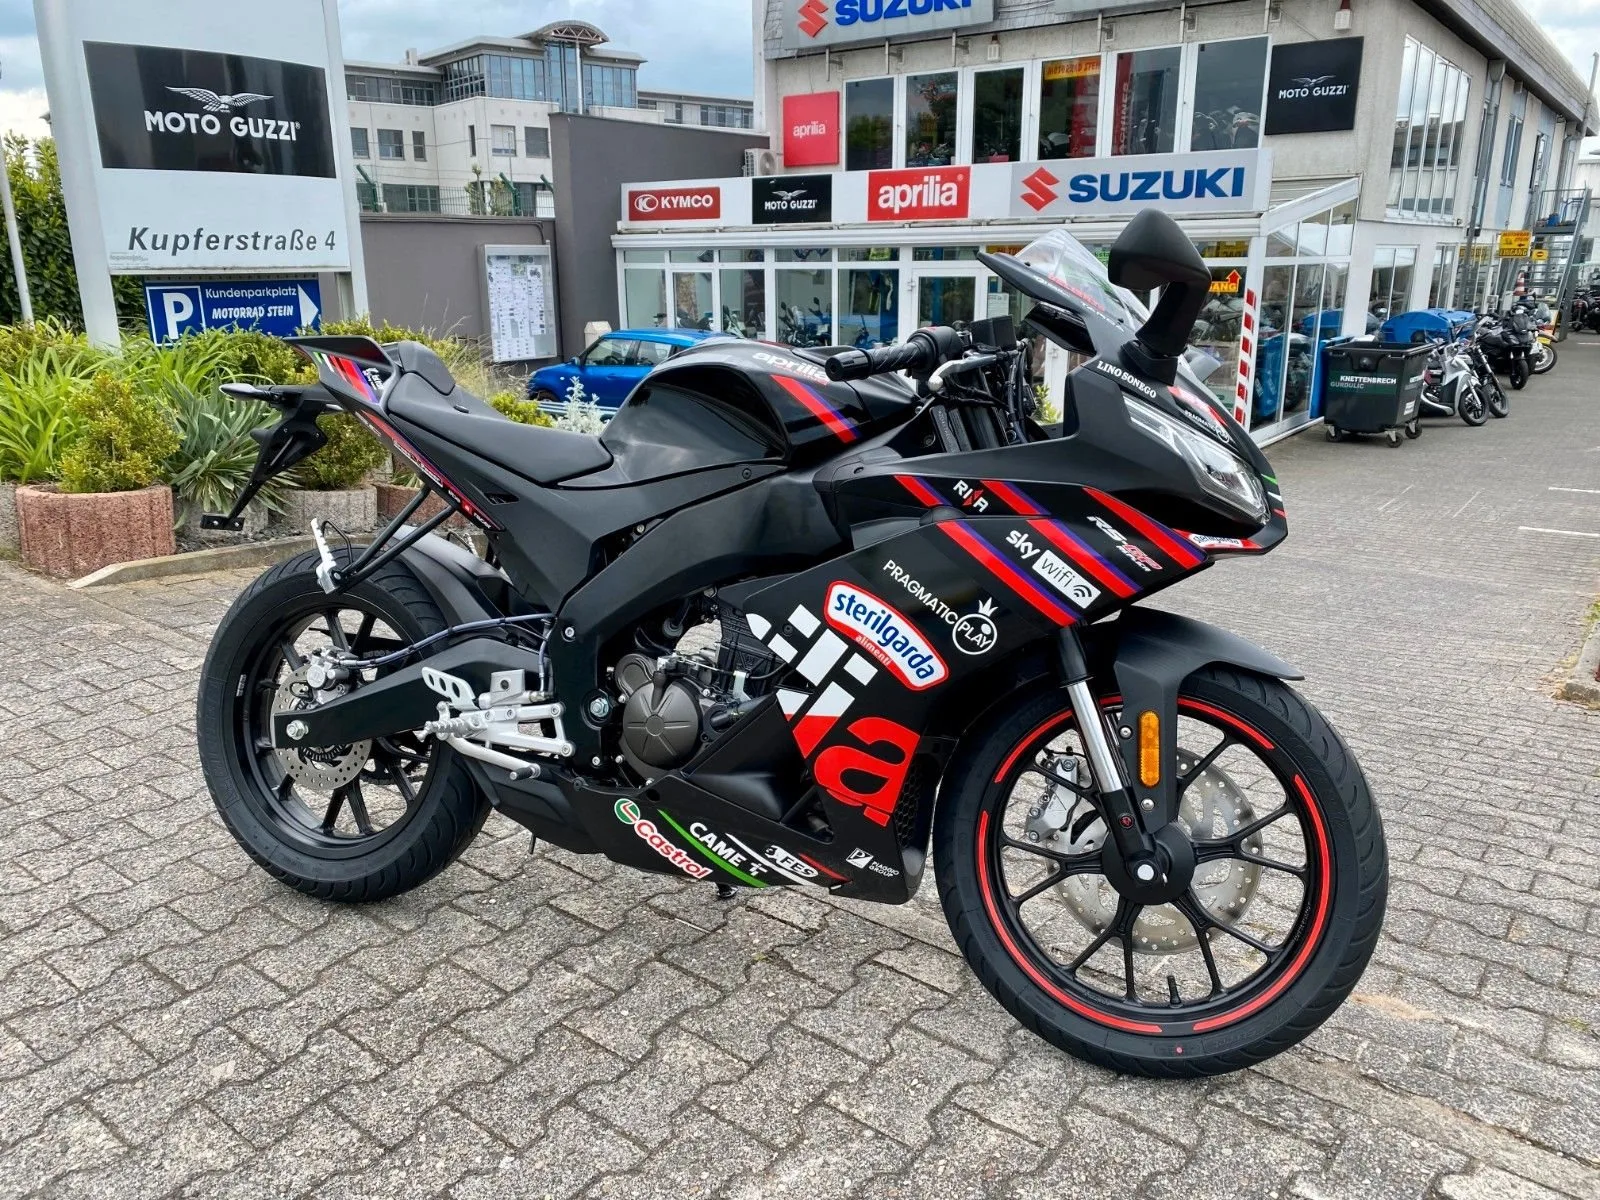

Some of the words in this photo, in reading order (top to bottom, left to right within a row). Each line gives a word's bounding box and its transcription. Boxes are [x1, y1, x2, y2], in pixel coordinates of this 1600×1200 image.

[834, 0, 972, 26] SUZU
[1278, 88, 1309, 99] MOTO
[1312, 85, 1347, 96] GUZZI
[143, 110, 221, 135] MOTO
[229, 116, 297, 141] GUZZI
[793, 121, 826, 138] aprilia
[878, 175, 958, 214] aprilia
[1068, 167, 1245, 203] SUZUKI
[661, 194, 713, 209] KYMCO
[764, 200, 788, 210] MOTO
[790, 199, 816, 209] GUZZI
[128, 227, 317, 256] Kupferstraße
[325, 230, 336, 250] 4
[205, 286, 297, 299] Kundenparkplatz
[162, 292, 194, 340] P
[212, 305, 264, 319] MOTORRAD
[267, 305, 294, 317] STEIN
[752, 352, 830, 381] aprilia
[1096, 361, 1122, 379] LINO
[1122, 372, 1157, 399] SONEGO
[1339, 375, 1397, 384] KNETTENBRECH
[1005, 530, 1040, 559] sky
[883, 559, 958, 625] PRAGMATIC
[834, 592, 935, 680] sterilgarda
[855, 633, 892, 666] alimenti
[957, 621, 992, 649] PLAY
[635, 820, 713, 879] Castrol
[689, 822, 747, 867] CAME
